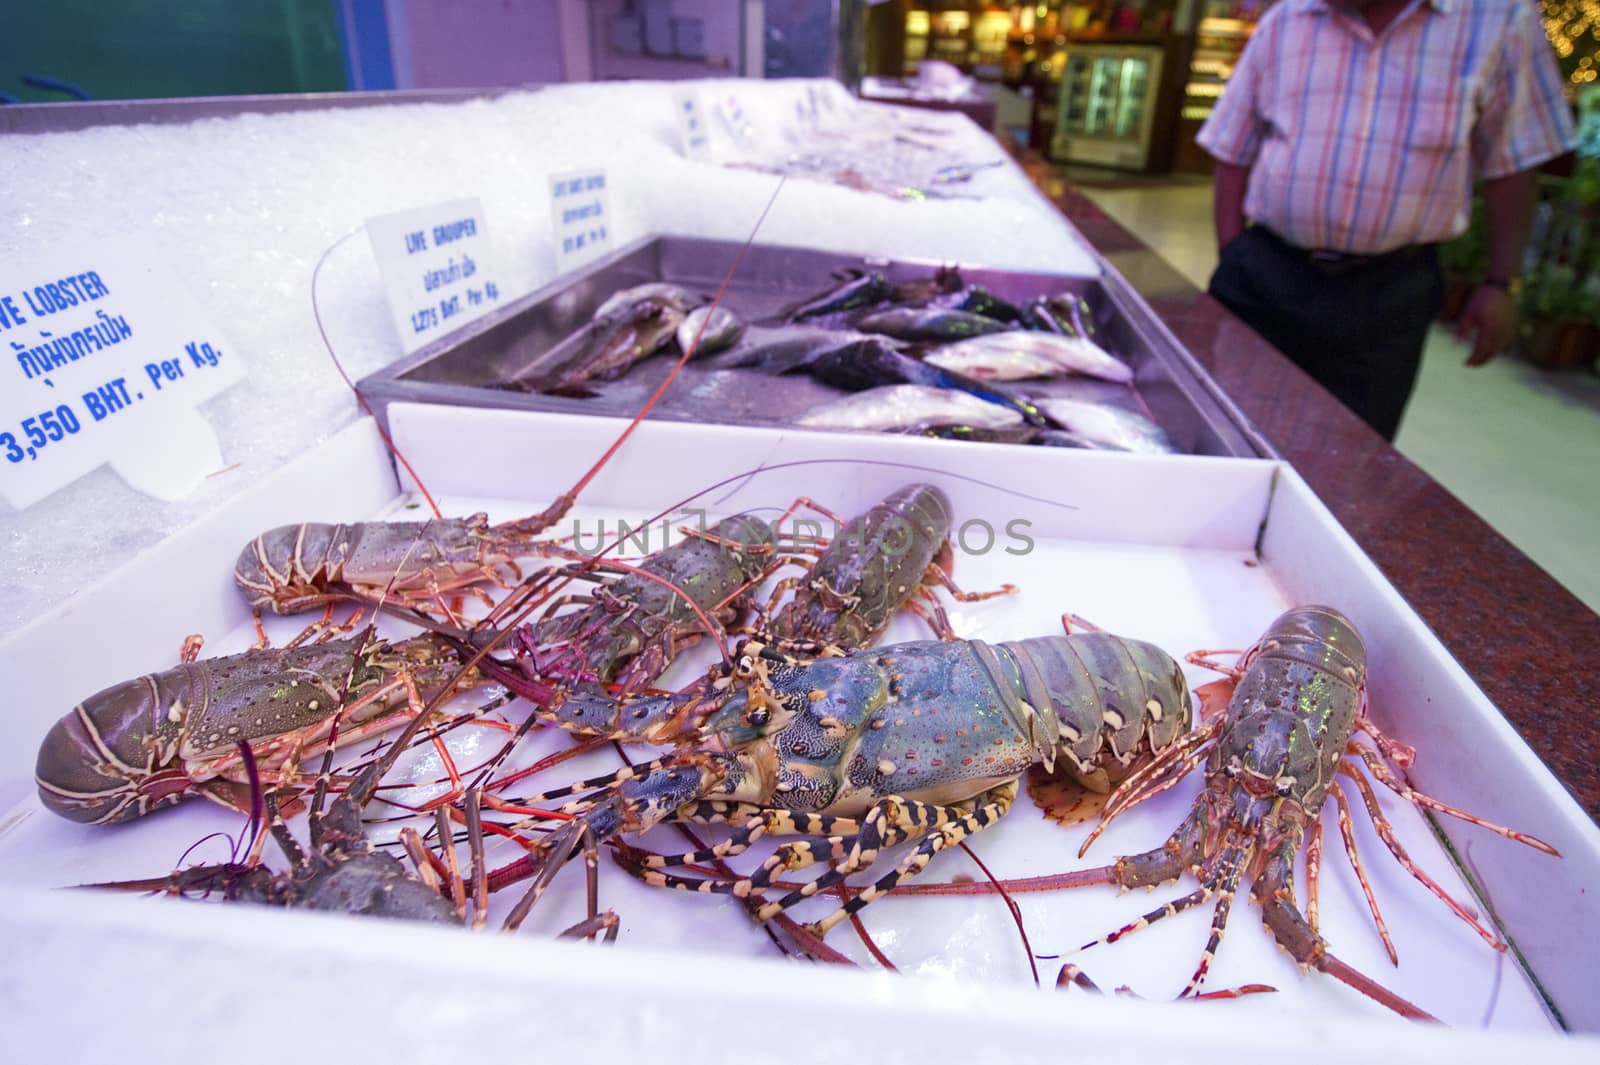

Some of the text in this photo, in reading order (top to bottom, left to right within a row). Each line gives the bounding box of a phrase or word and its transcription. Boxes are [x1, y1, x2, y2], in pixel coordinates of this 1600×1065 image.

[22, 270, 110, 317] LOBSTER
[0, 404, 81, 464] 3,550
[144, 357, 185, 391] Per
[184, 341, 223, 369] Kg.
